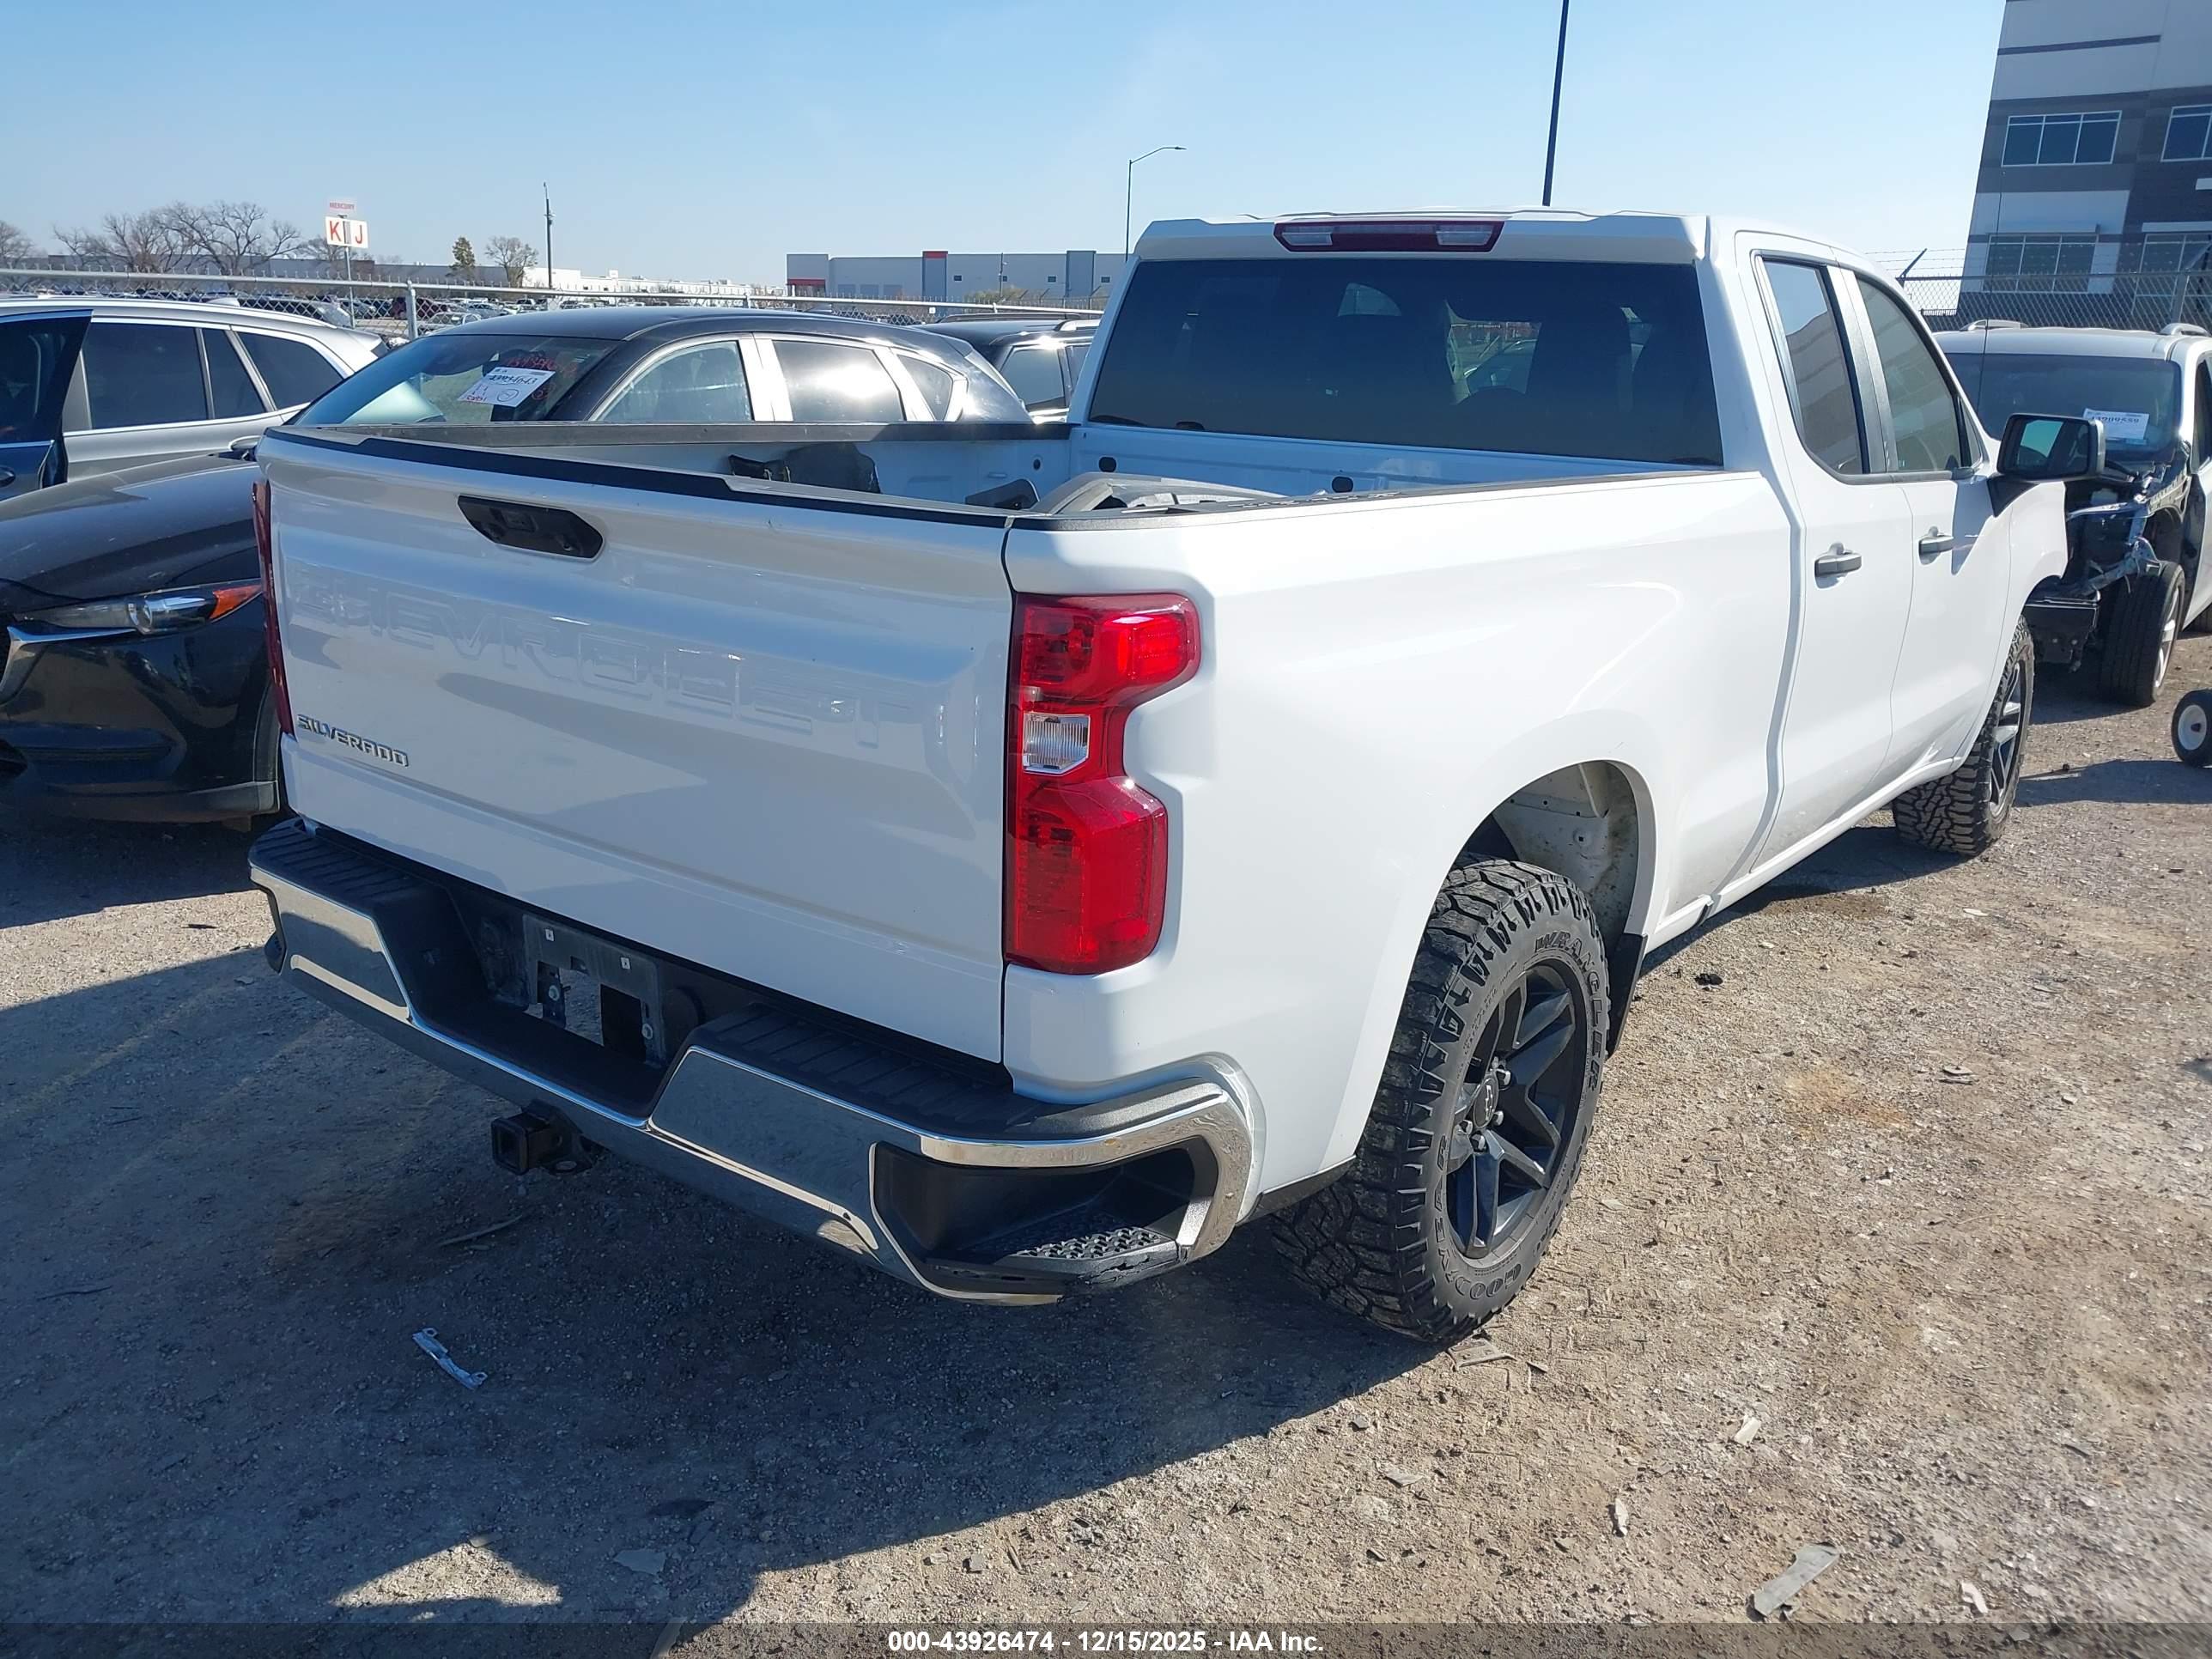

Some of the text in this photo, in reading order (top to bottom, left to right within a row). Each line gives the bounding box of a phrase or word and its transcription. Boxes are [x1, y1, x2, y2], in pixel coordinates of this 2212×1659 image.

[329, 220, 363, 244] K J
[296, 714, 410, 768] SILVERADO
[1534, 930, 1603, 1091] WRANGLER
[1433, 1134, 1522, 1300] GOODYEAR
